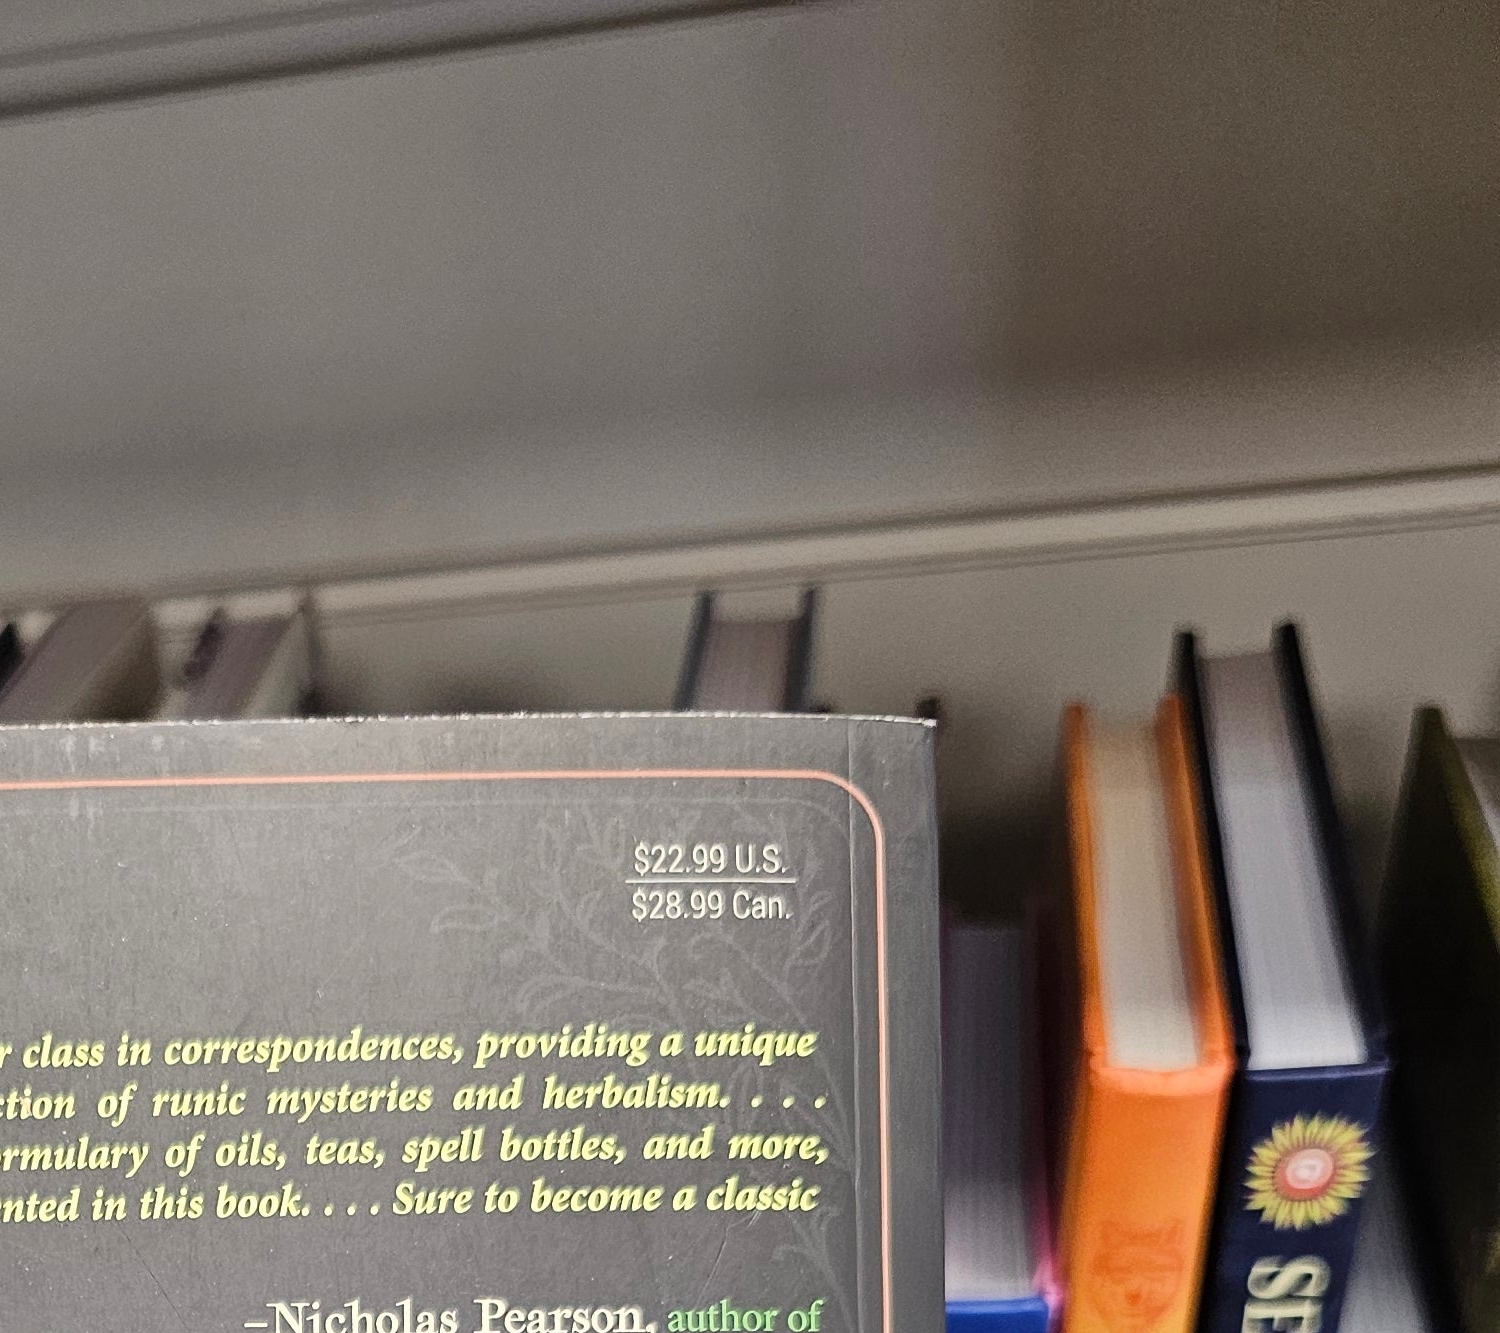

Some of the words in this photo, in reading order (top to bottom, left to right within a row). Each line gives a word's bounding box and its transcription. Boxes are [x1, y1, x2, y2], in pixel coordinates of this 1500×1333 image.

[634, 841, 726, 877] $22.99
[733, 842, 788, 875] U.S.
[631, 888, 723, 924] $28.99
[732, 890, 794, 921] Can.
[23, 1032, 104, 1068] class
[118, 1032, 151, 1066] in
[165, 1025, 463, 1073] correspondences,
[473, 1024, 652, 1068] providing
[660, 1032, 683, 1056] a
[695, 1022, 819, 1066] unique
[668, 1298, 779, 1332] author
[788, 1300, 824, 1332] of
